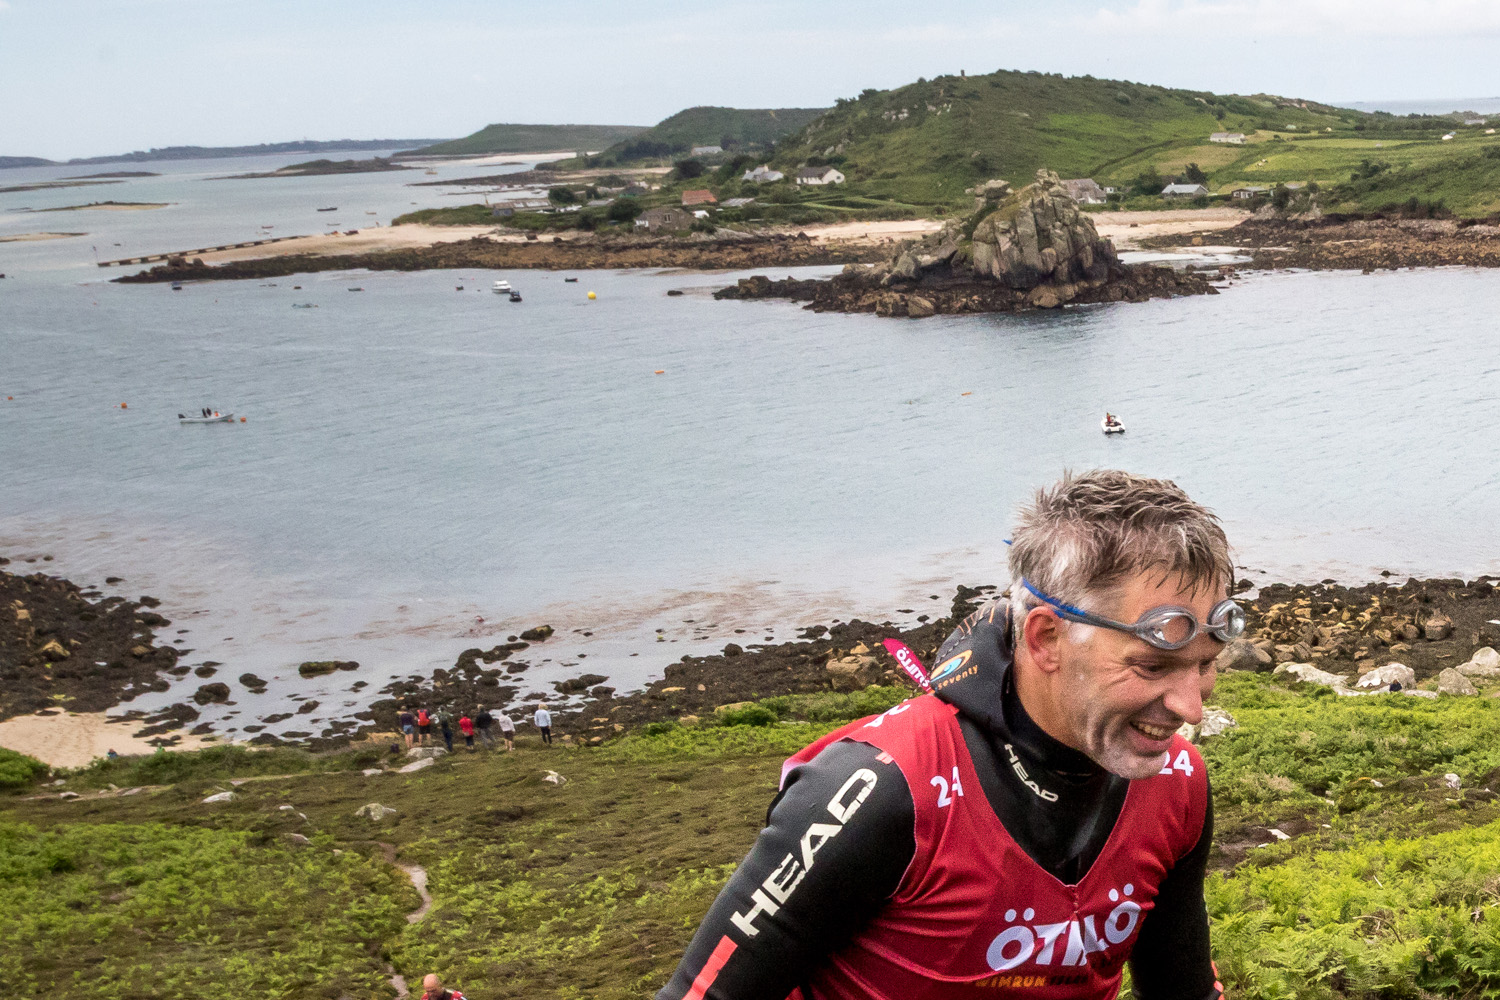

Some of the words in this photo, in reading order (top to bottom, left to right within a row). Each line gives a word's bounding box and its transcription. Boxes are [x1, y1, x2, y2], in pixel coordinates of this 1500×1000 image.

[930, 766, 964, 808] 24
[1004, 743, 1058, 802] HEAD
[730, 768, 878, 937] HEAD
